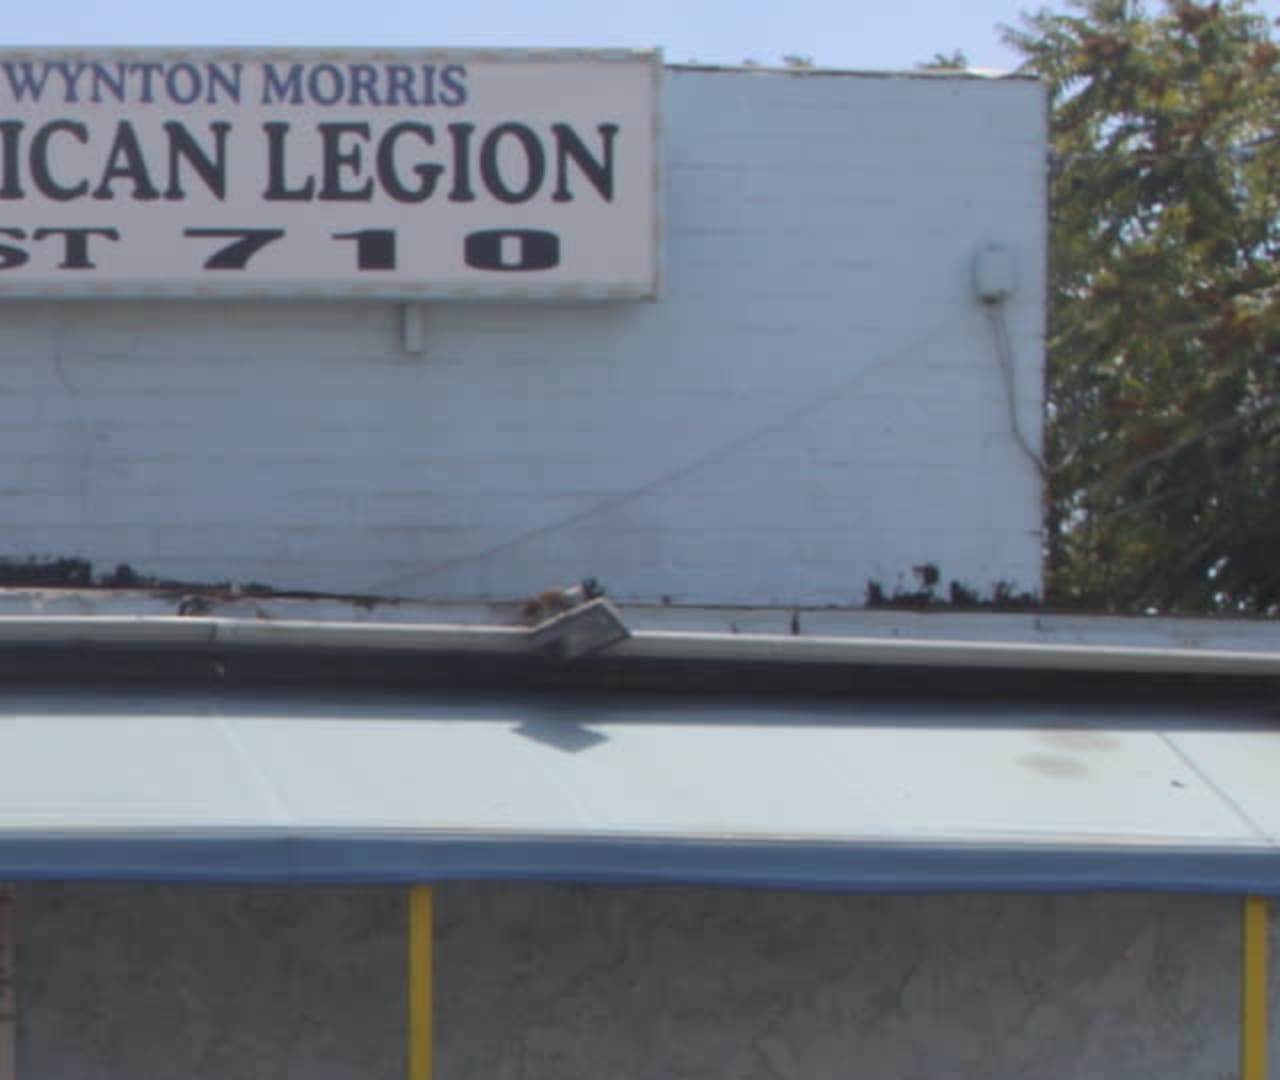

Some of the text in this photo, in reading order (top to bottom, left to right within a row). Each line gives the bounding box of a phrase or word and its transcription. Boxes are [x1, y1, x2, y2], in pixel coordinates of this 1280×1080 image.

[0, 62, 244, 106] WYNTON
[260, 62, 468, 107] MORRIS
[262, 121, 621, 205] LEGION
